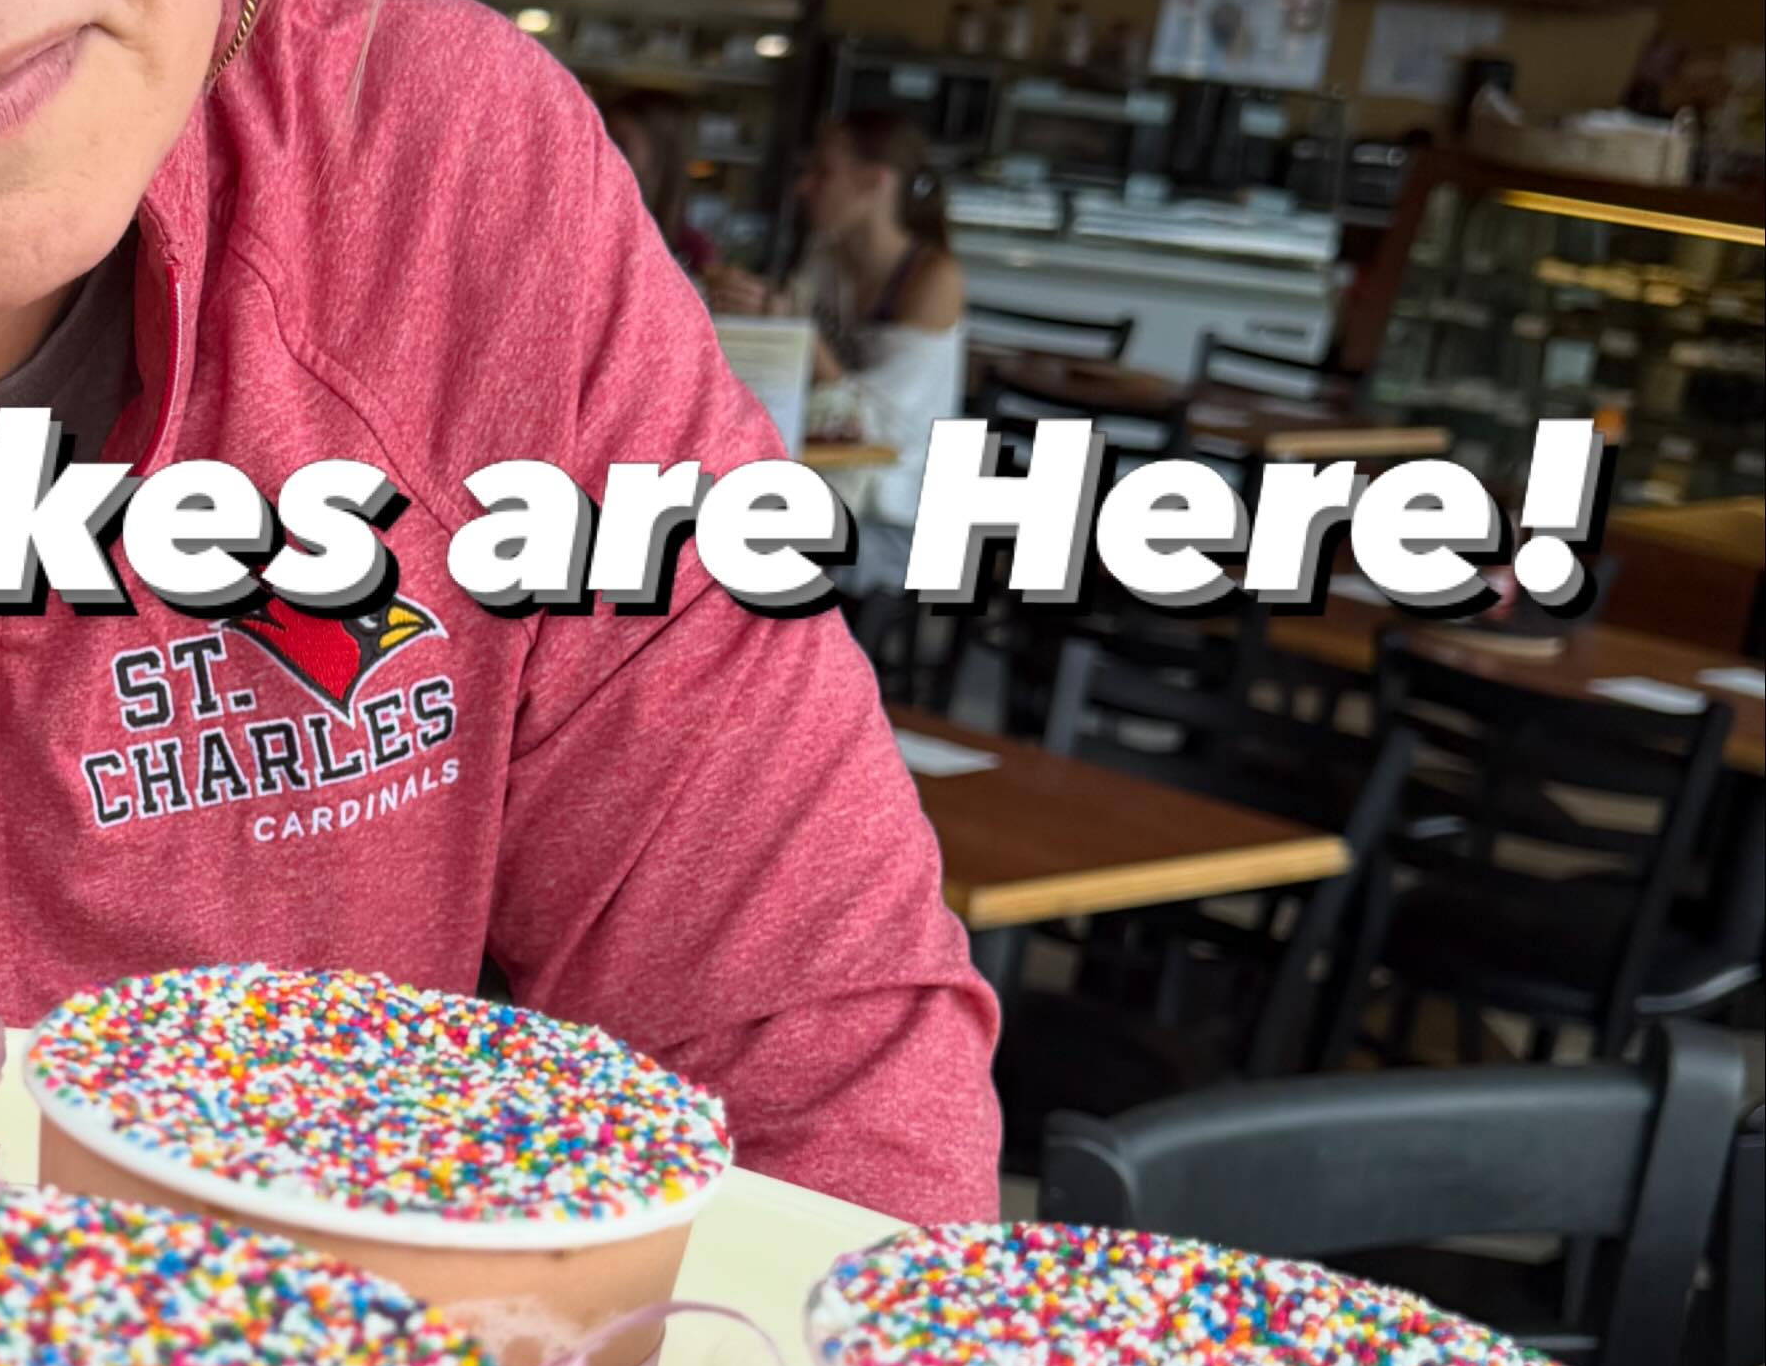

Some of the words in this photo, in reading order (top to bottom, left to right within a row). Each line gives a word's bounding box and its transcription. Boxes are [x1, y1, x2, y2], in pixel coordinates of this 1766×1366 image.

[111, 634, 256, 730] ST.
[81, 675, 456, 828] CHARLES
[253, 759, 459, 842] CARDINALS
